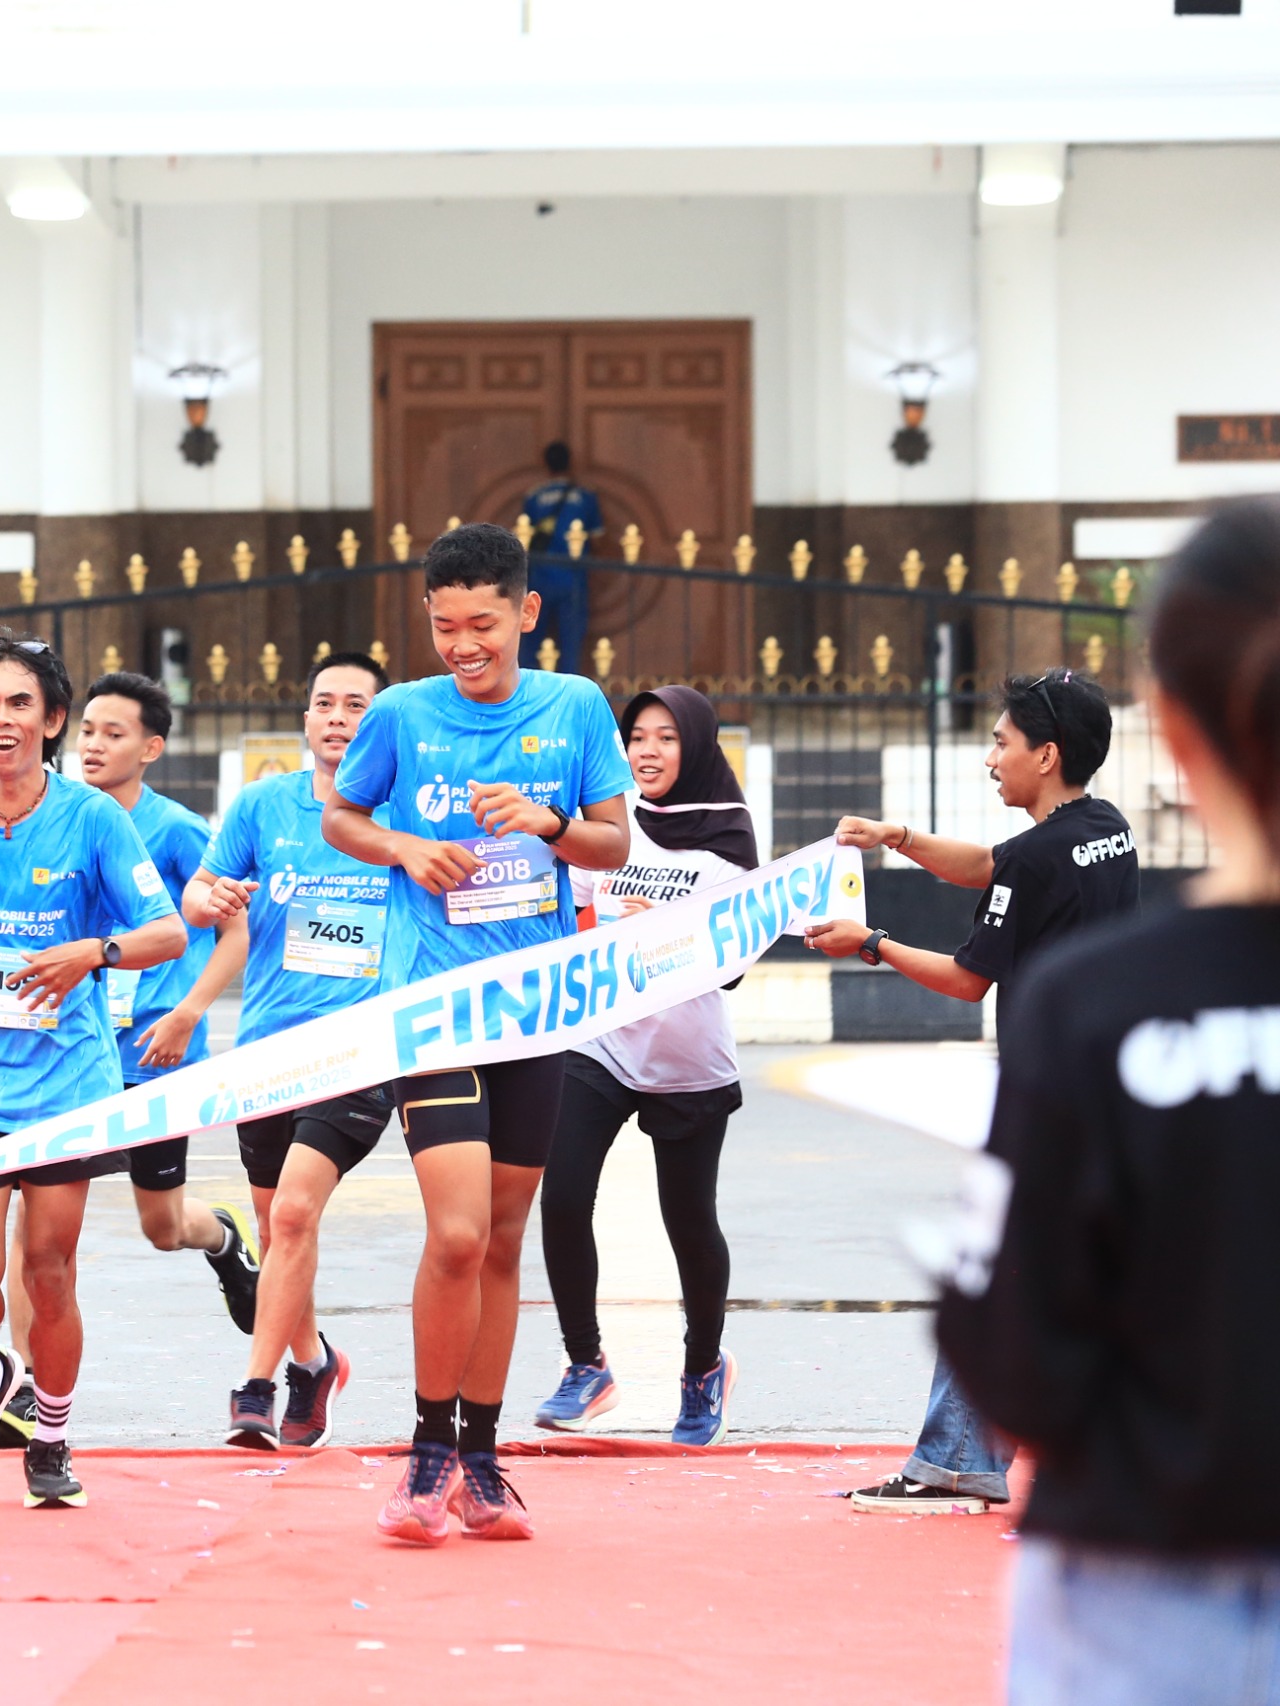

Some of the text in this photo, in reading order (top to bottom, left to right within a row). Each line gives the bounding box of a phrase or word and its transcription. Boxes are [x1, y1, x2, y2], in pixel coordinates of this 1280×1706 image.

[541, 738, 567, 748] PLN
[532, 782, 561, 793] RUN
[1072, 828, 1136, 867] OFFICIA
[51, 872, 76, 880] PLN
[296, 875, 320, 885] PLN
[322, 876, 370, 886] MOBILE
[470, 858, 531, 885] 8018
[296, 886, 387, 899] BANUA 2025
[540, 882, 554, 897] M
[599, 879, 691, 901] RUNNERS
[38, 910, 65, 922] RUN
[983, 914, 1004, 927] LN
[18, 923, 56, 936] 2025
[308, 920, 364, 944] 7405
[643, 951, 655, 962] PLN
[655, 938, 678, 958] MOBILE
[646, 957, 676, 979] BANUA
[393, 941, 618, 1072] FINISH
[239, 1048, 359, 1097] PLN MOBILE RUN
[243, 1065, 352, 1113] BANUA 2025
